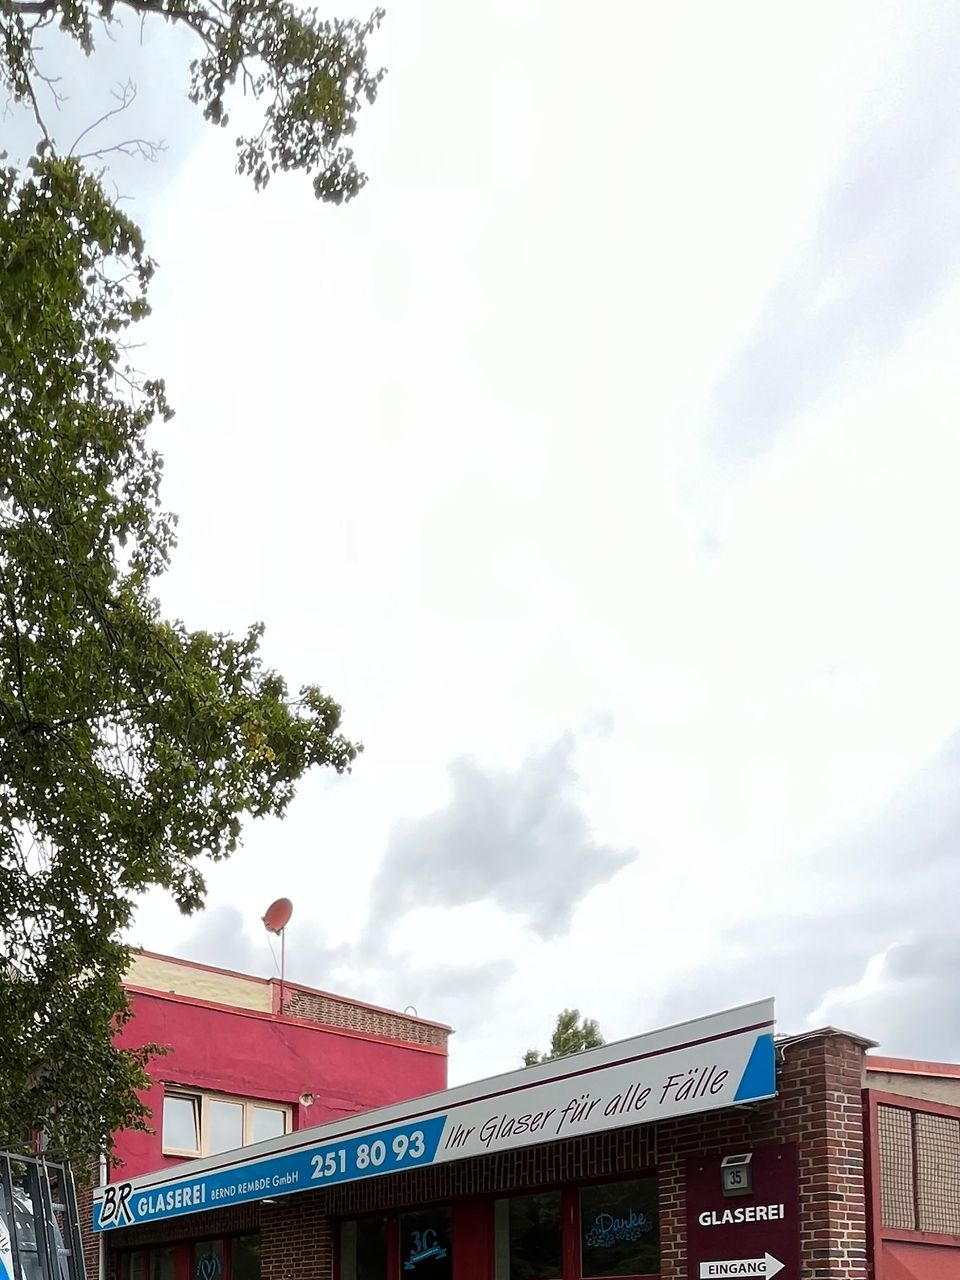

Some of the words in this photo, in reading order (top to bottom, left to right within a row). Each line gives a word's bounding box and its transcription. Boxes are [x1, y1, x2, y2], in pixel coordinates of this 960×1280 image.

[445, 1123, 476, 1150] Ihr
[479, 1106, 557, 1147] Glaser
[556, 1093, 601, 1134] für
[604, 1083, 652, 1116] alle
[659, 1065, 730, 1104] Fälle
[98, 1182, 136, 1227] BR
[138, 1184, 206, 1216] GLASEREI
[211, 1185, 236, 1200] BERND
[238, 1177, 270, 1194] REMBDE
[272, 1170, 299, 1187] GmbH
[311, 1149, 348, 1180] 251
[356, 1140, 387, 1170] 80
[392, 1130, 425, 1162] 93
[730, 1170, 742, 1185] 35
[596, 1207, 647, 1232] Danke
[698, 1204, 785, 1226] GLASEREI
[708, 1261, 767, 1275] EINGANG
